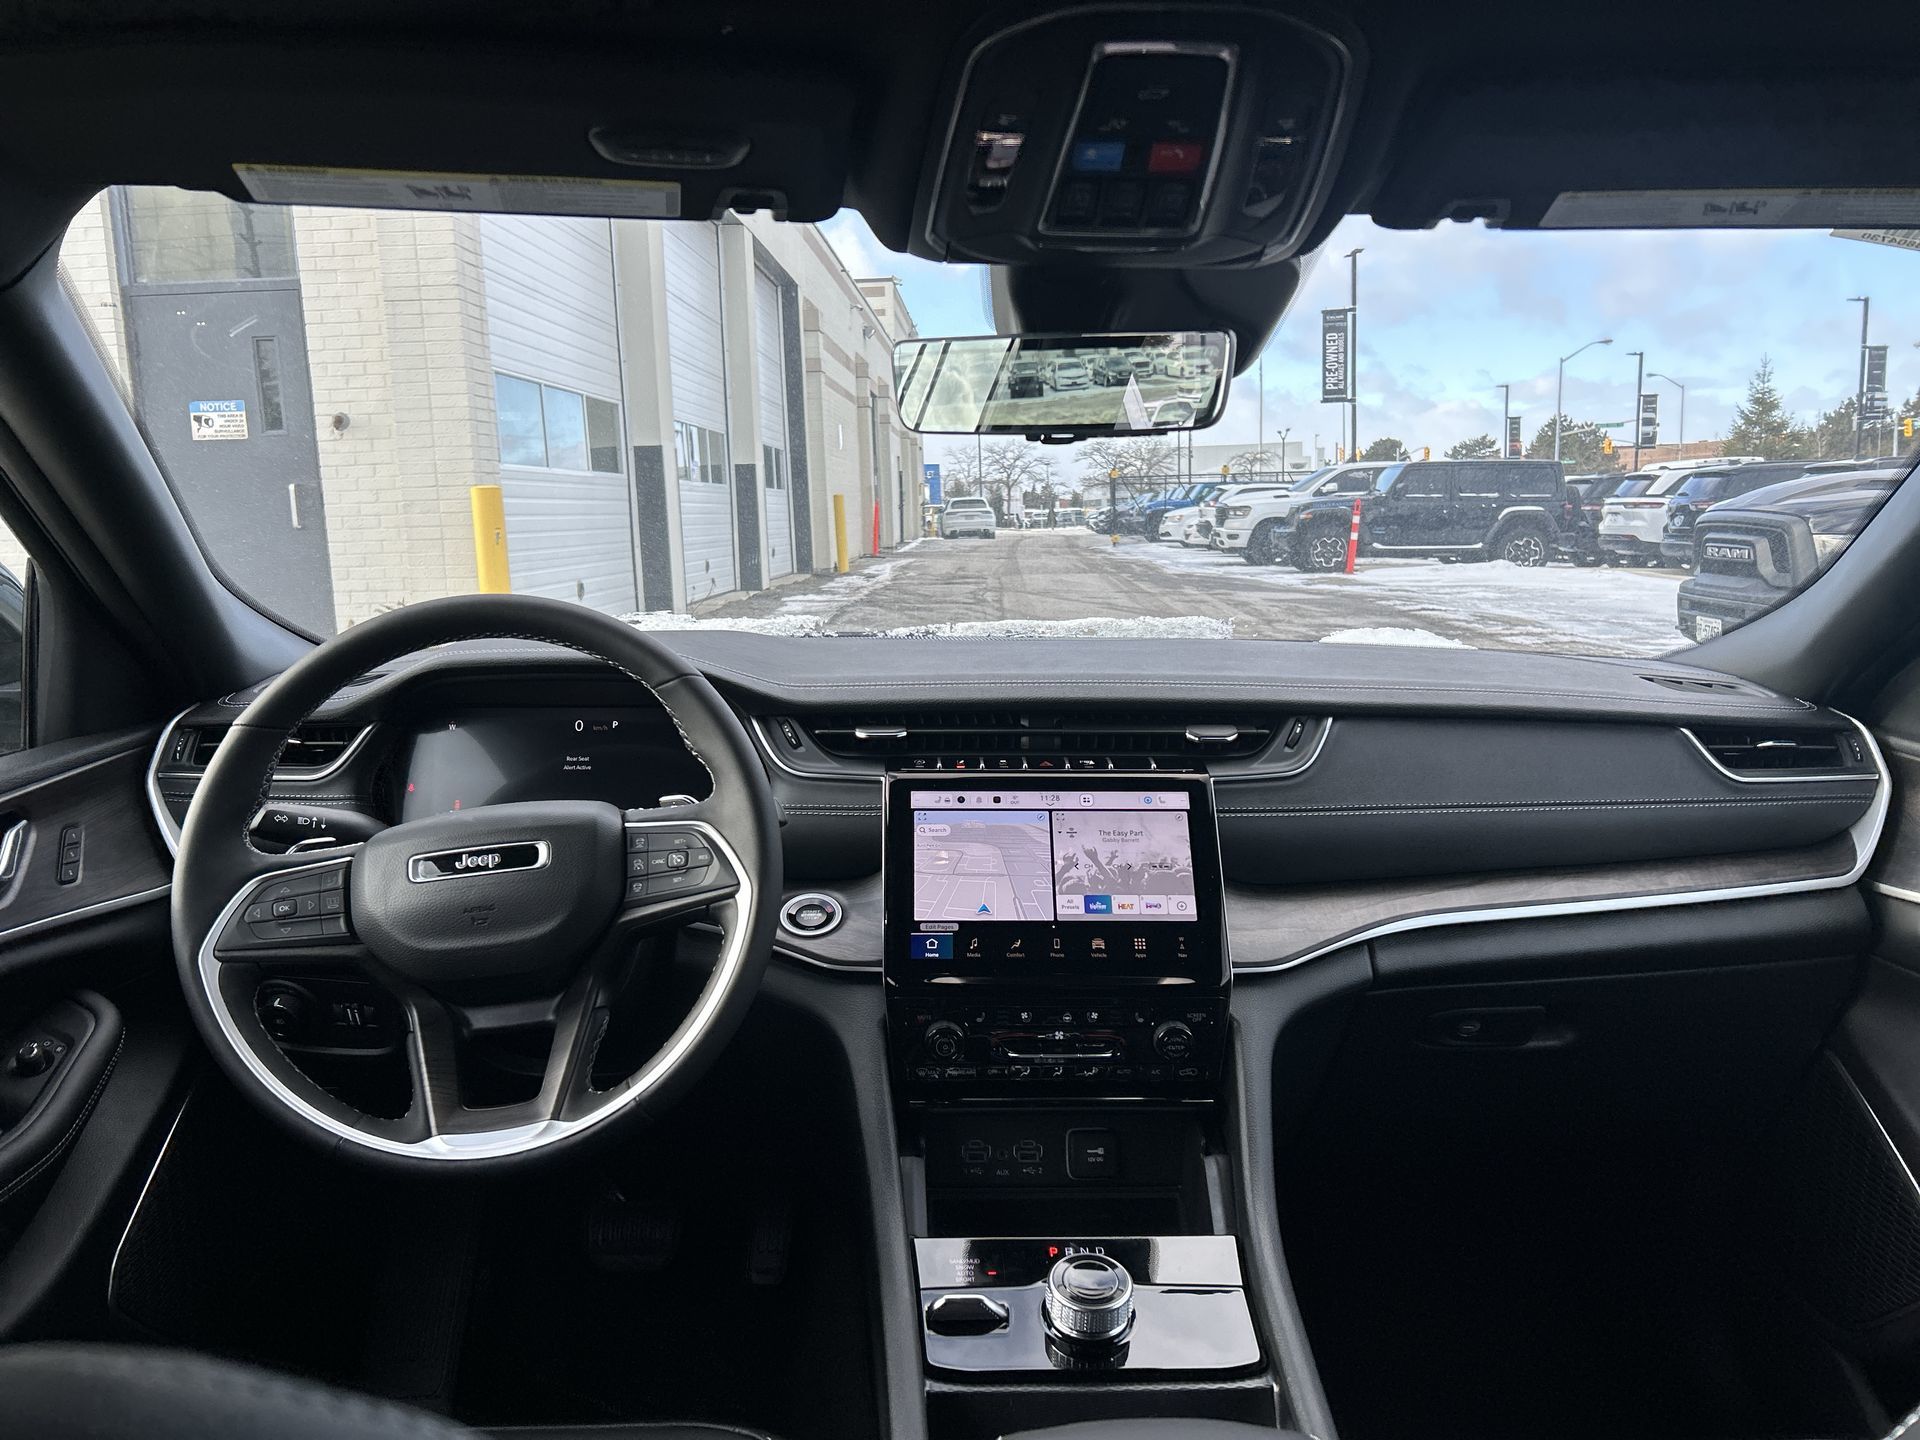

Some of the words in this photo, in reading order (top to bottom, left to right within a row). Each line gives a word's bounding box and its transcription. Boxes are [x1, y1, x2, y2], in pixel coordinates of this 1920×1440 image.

[1325, 332, 1338, 390] PRE-OWNED
[199, 402, 237, 411] NOTICE
[1706, 546, 1748, 559] RAM
[574, 719, 584, 732] 0
[612, 720, 619, 729] P
[1040, 794, 1060, 802] 11:28
[928, 826, 947, 834] Search
[1098, 829, 1111, 837] The
[1112, 829, 1128, 838] Easy
[1129, 829, 1144, 837] Part
[455, 853, 502, 869] Jeep
[996, 1168, 1010, 1176] AUX
[1049, 1247, 1058, 1257] P
[1095, 1247, 1105, 1255] D
